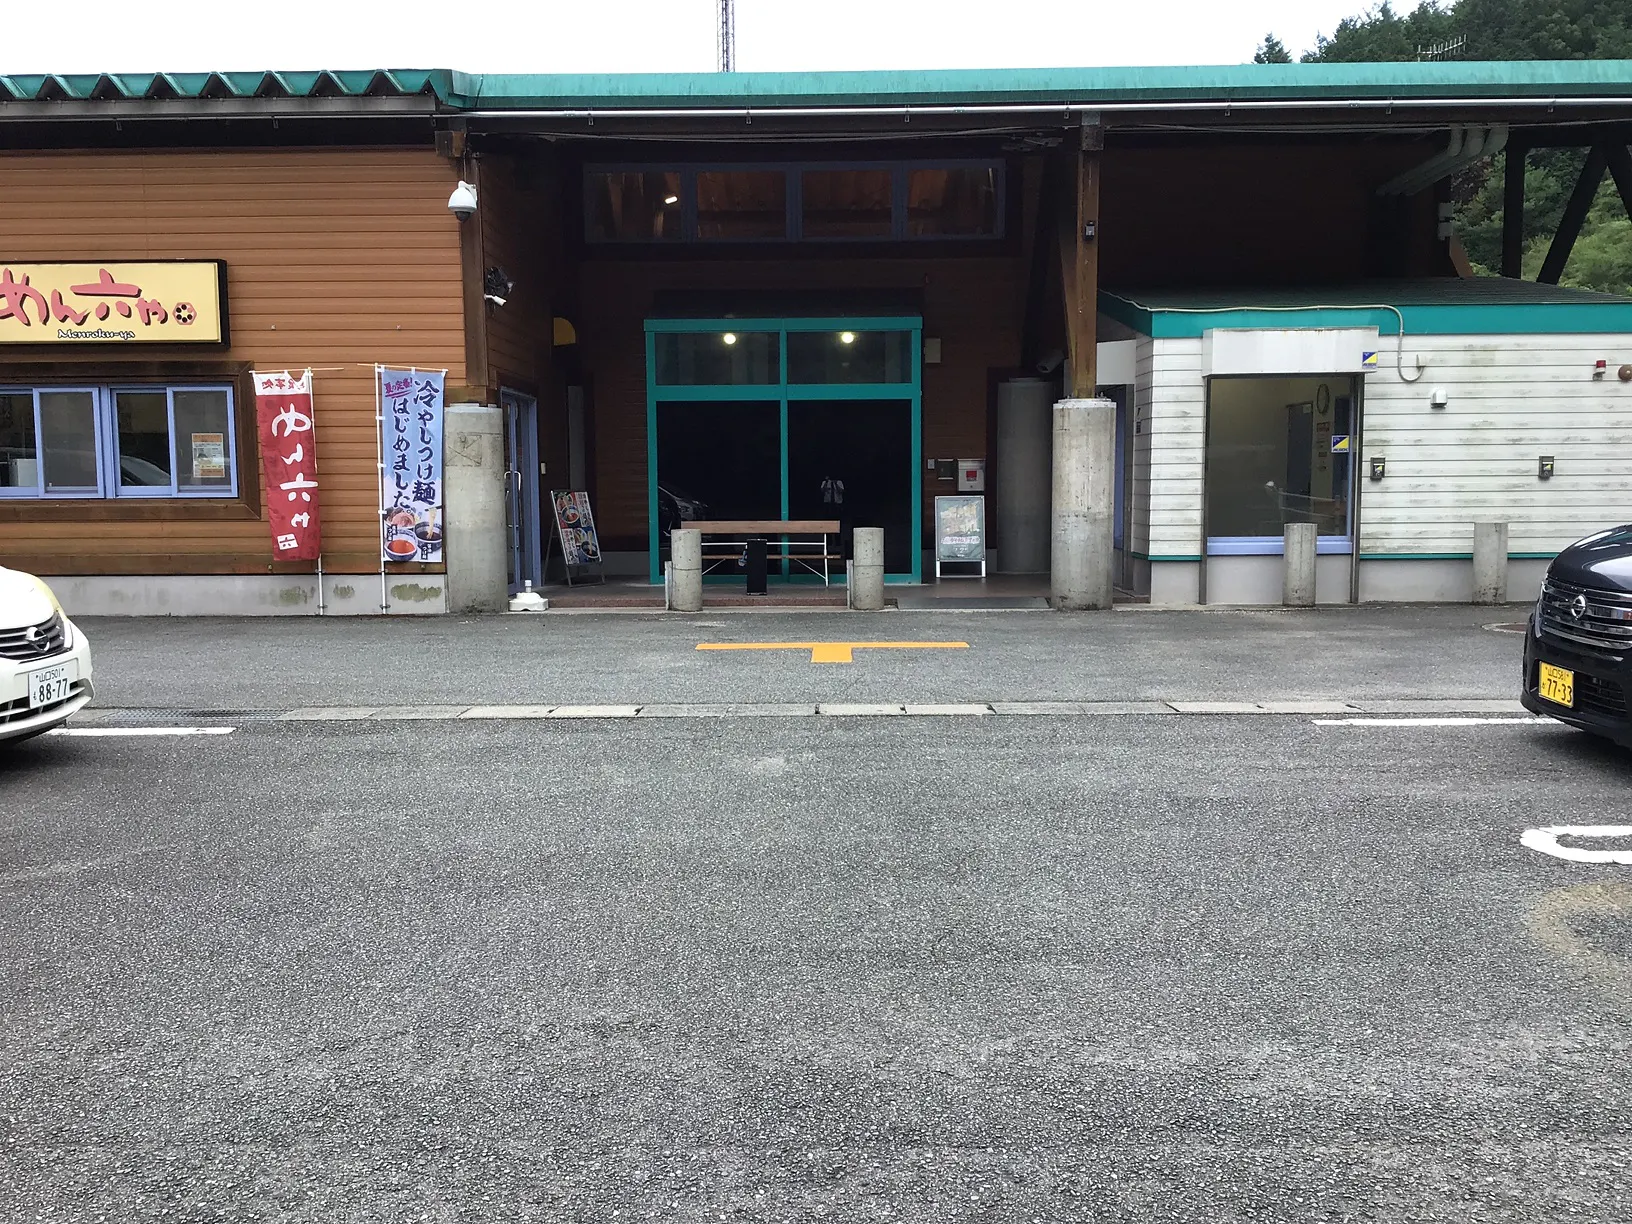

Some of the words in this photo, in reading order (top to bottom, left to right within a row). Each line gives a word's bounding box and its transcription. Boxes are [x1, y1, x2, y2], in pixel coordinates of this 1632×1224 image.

[0, 268, 168, 326] めん六や
[57, 328, 136, 340] Menroku-ya
[413, 380, 440, 506] 冷やしつけ麺
[39, 668, 61, 682] 山口501
[39, 677, 68, 702] 88-77
[1547, 678, 1572, 703] 77-33
